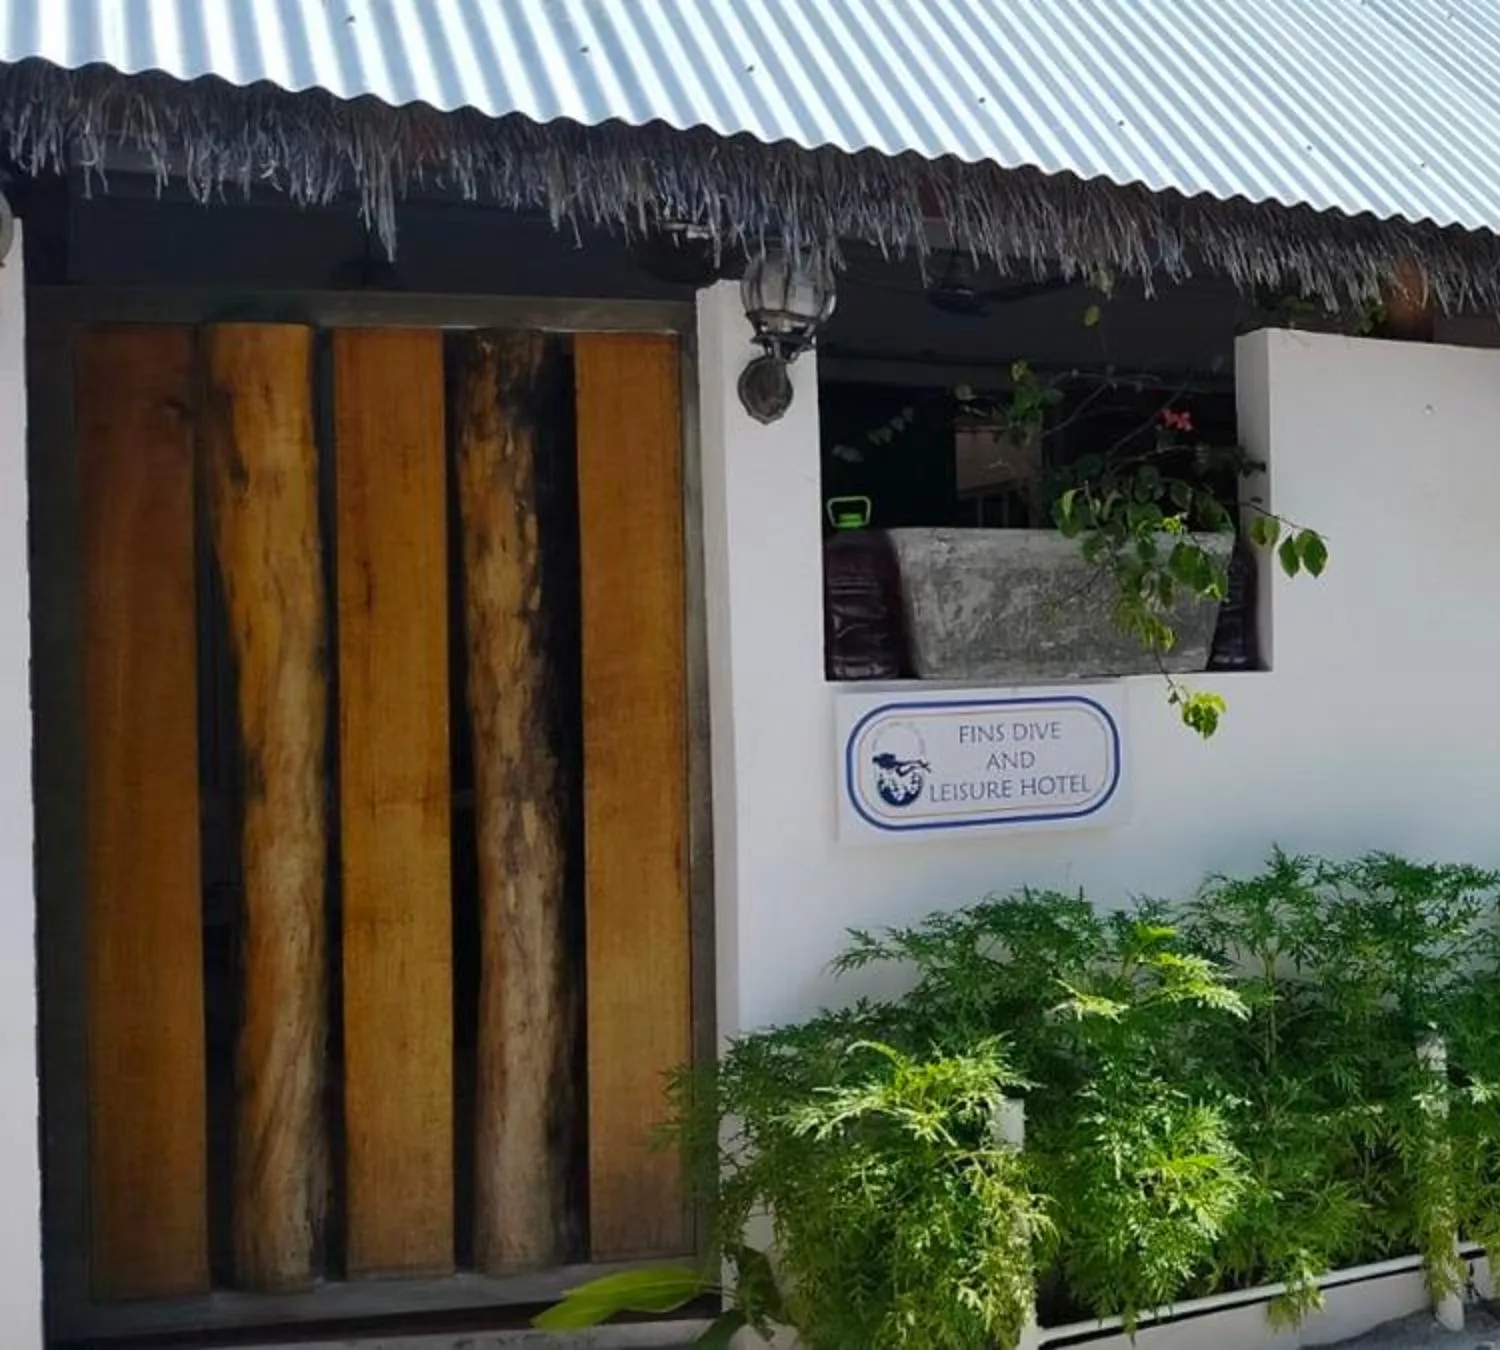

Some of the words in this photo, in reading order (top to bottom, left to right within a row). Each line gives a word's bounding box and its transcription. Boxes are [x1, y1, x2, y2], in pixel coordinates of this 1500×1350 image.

[958, 724, 1006, 744] FINS
[1012, 721, 1062, 742] DIVE
[985, 751, 1036, 770] AND
[929, 780, 1012, 803] LEISURE
[1020, 774, 1092, 797] HOTEL
